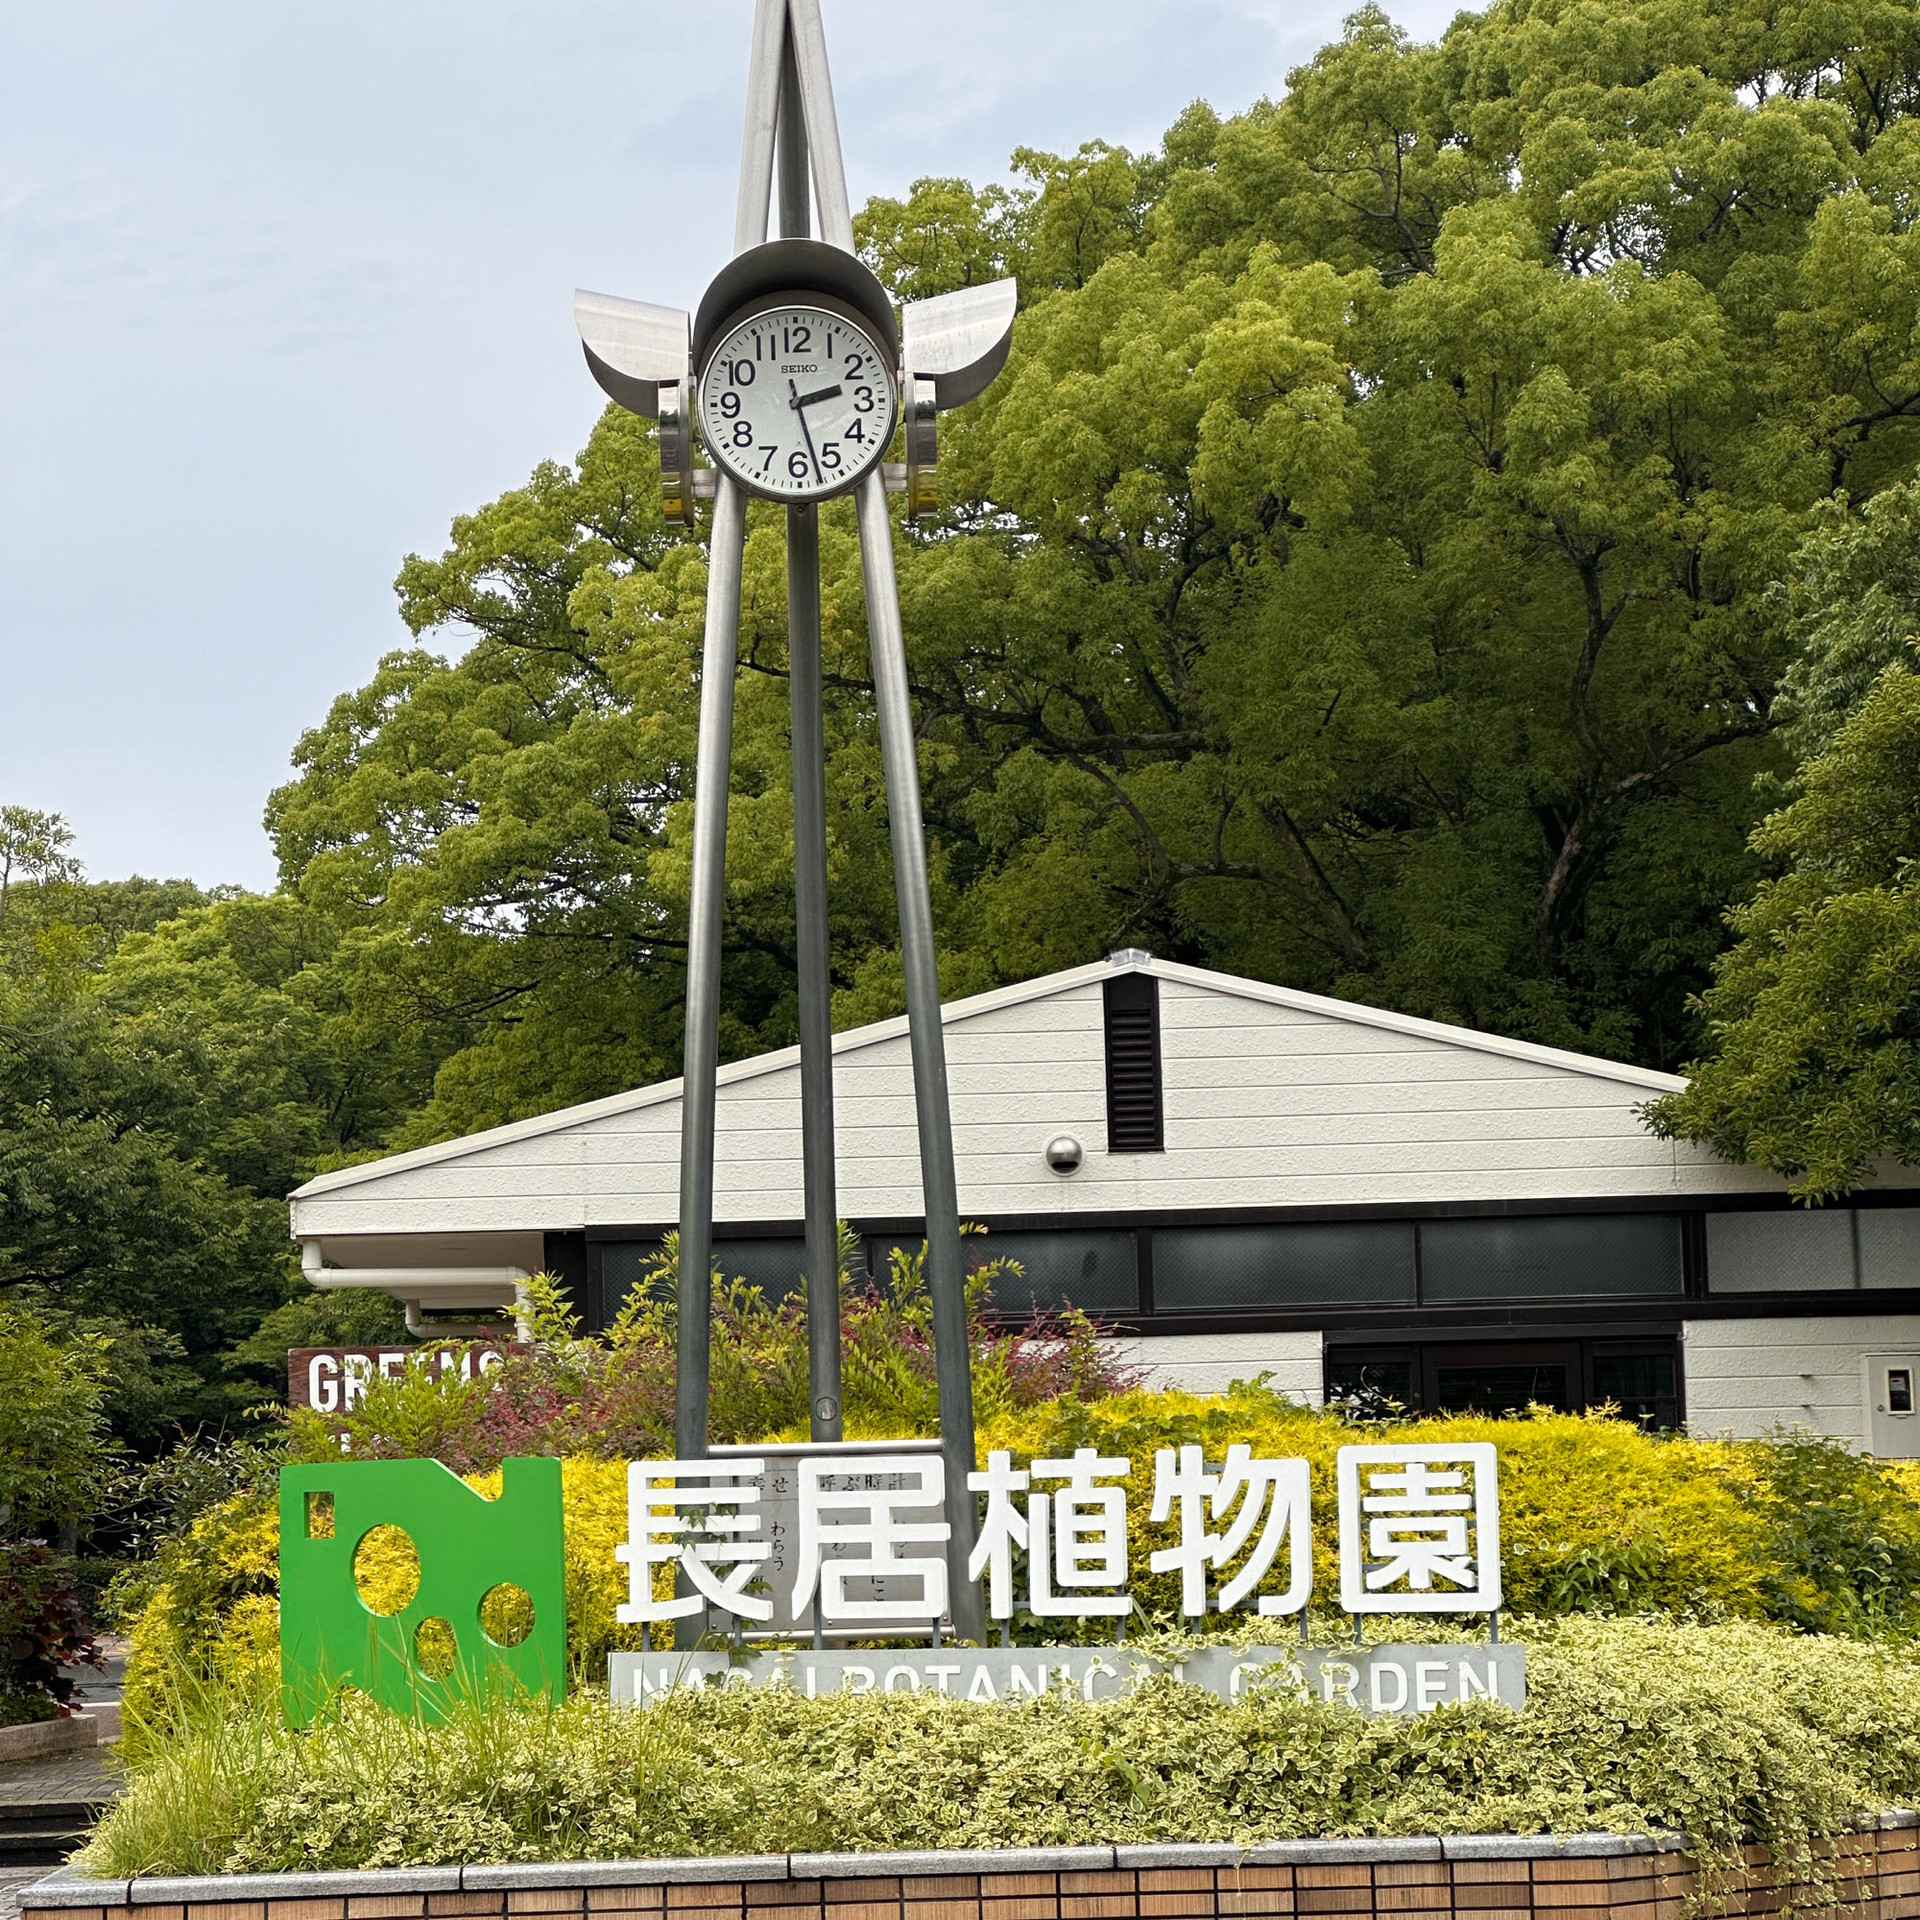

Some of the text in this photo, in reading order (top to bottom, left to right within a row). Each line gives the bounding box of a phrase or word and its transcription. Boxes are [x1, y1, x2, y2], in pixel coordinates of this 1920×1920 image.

[756, 334, 776, 361] 11
[784, 326, 811, 353] 12
[728, 359, 756, 386] 10
[781, 364, 818, 373] SEIKO
[844, 354, 864, 380] 2
[720, 391, 741, 419] 9
[853, 386, 875, 413] 3
[732, 420, 753, 447] 8
[844, 418, 865, 443] 4
[758, 445, 778, 471] 7
[788, 451, 808, 479] 6
[821, 442, 841, 469] 5
[616, 1442, 1503, 1623] 長居植物園
